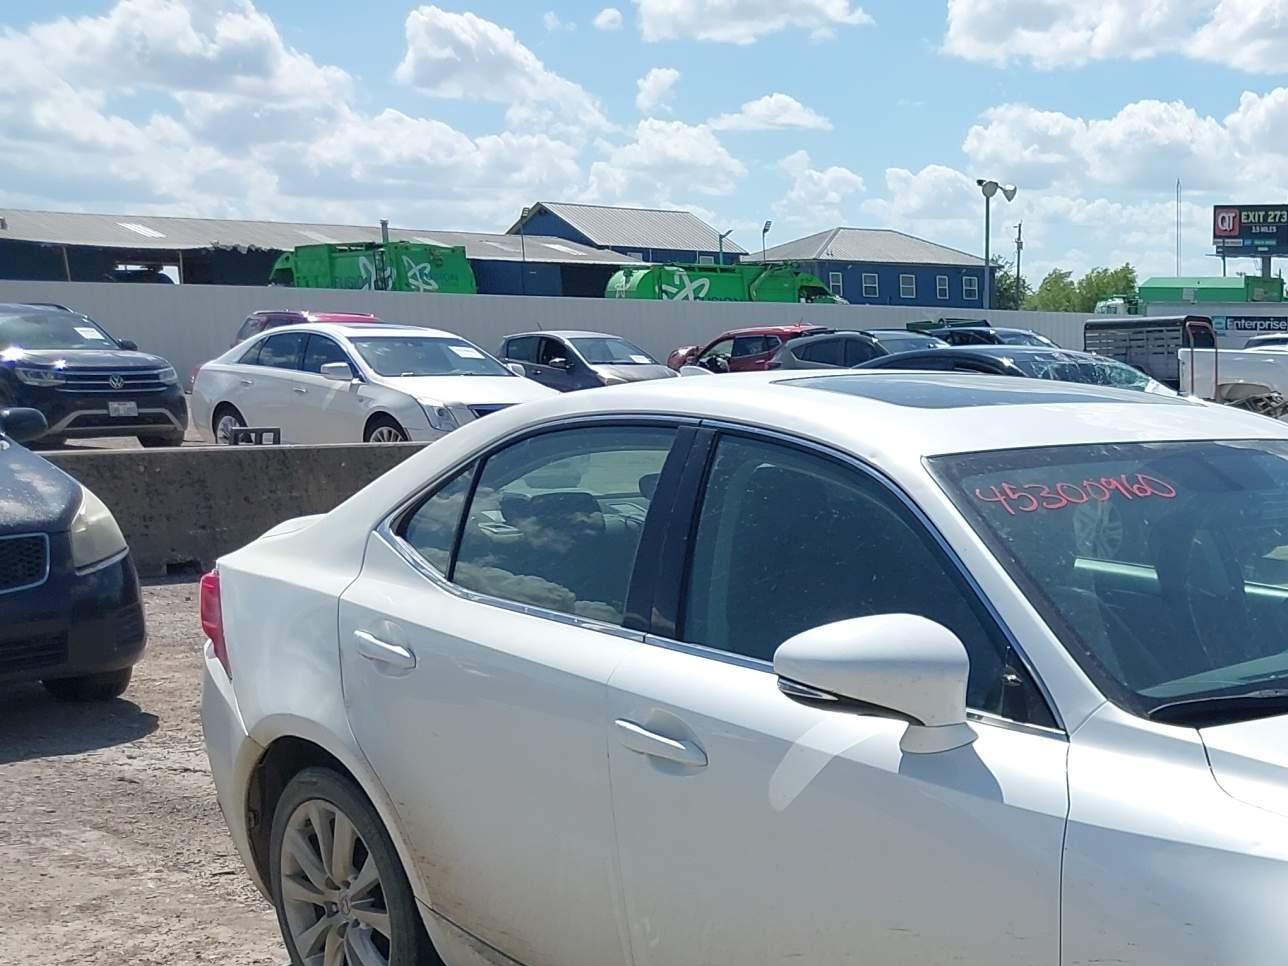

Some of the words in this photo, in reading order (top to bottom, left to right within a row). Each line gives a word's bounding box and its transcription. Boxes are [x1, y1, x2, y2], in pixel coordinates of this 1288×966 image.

[1218, 212, 1236, 232] QT
[1241, 212, 1266, 223] EXIT
[1267, 212, 1288, 223] 273
[1226, 318, 1288, 331] Enterprise
[975, 473, 1177, 516] 45300960
